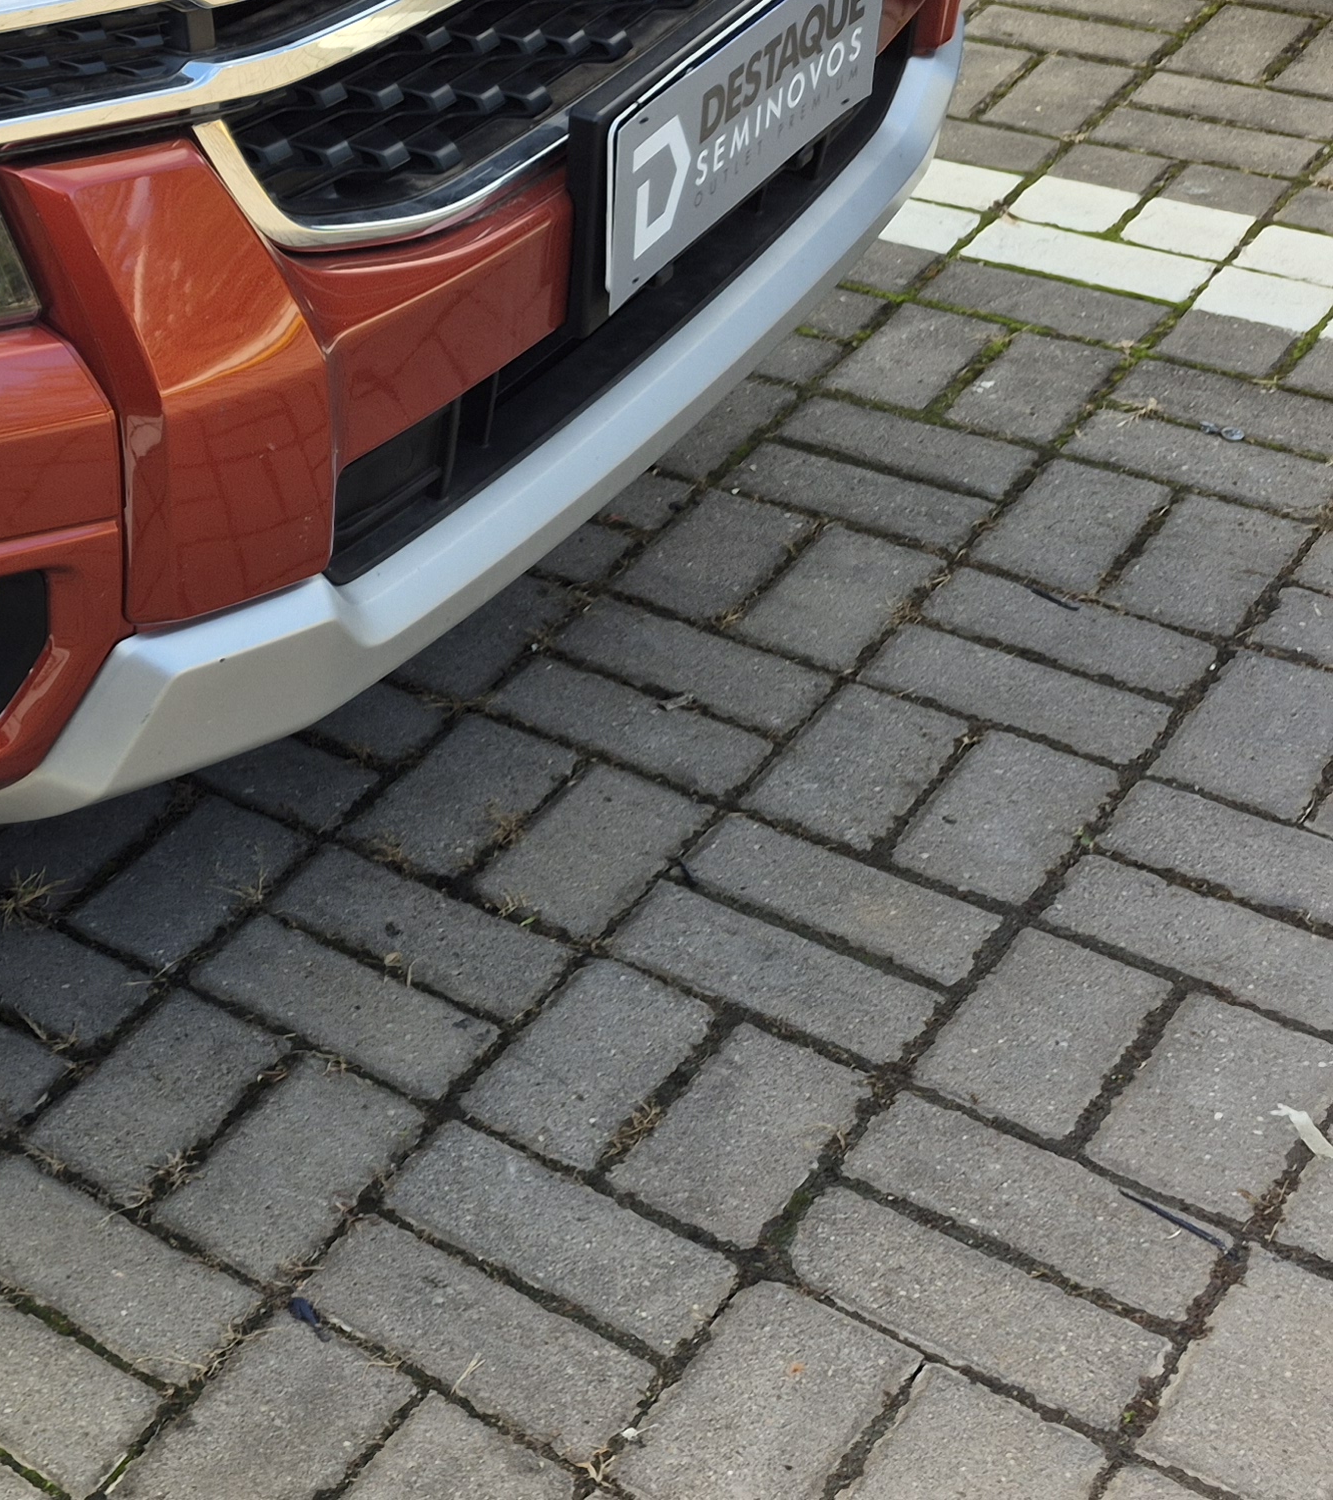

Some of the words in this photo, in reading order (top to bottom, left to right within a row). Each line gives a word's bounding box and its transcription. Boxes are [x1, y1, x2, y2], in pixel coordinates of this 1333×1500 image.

[694, 139, 764, 208] OUTLET
[777, 68, 860, 140] PREMIUM
[696, 26, 863, 187] SEMINOVOS
